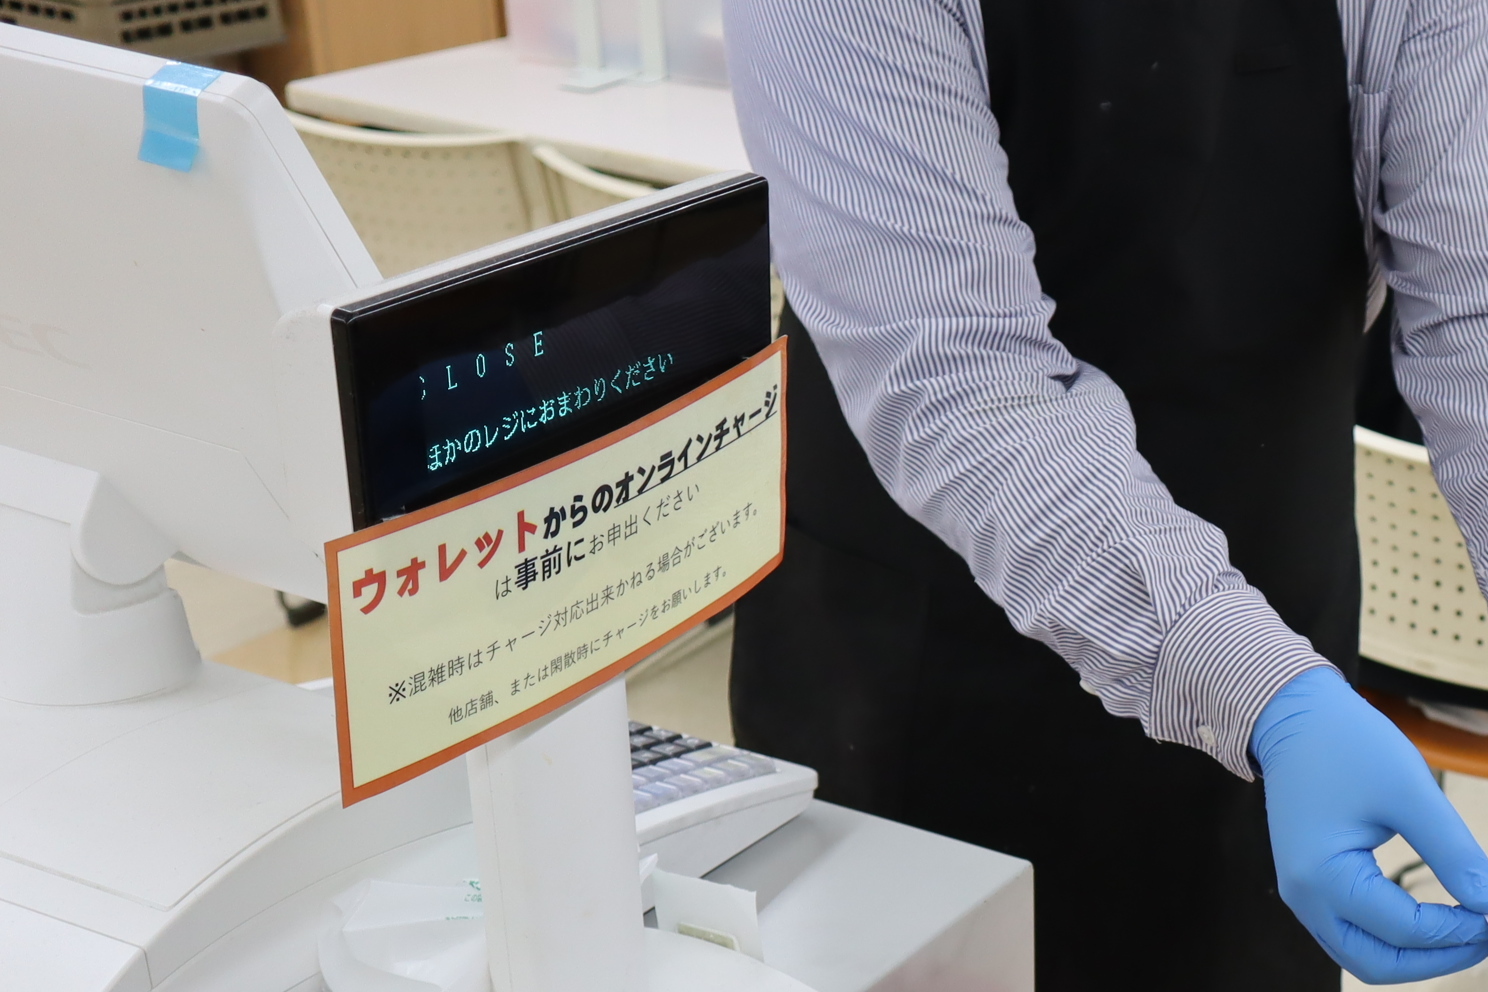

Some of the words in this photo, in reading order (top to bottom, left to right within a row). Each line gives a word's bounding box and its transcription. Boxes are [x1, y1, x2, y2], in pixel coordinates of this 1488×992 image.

[352, 383, 779, 615] ウォレットからのオンラインチャージ
[495, 484, 700, 600] は事前にお申出ください
